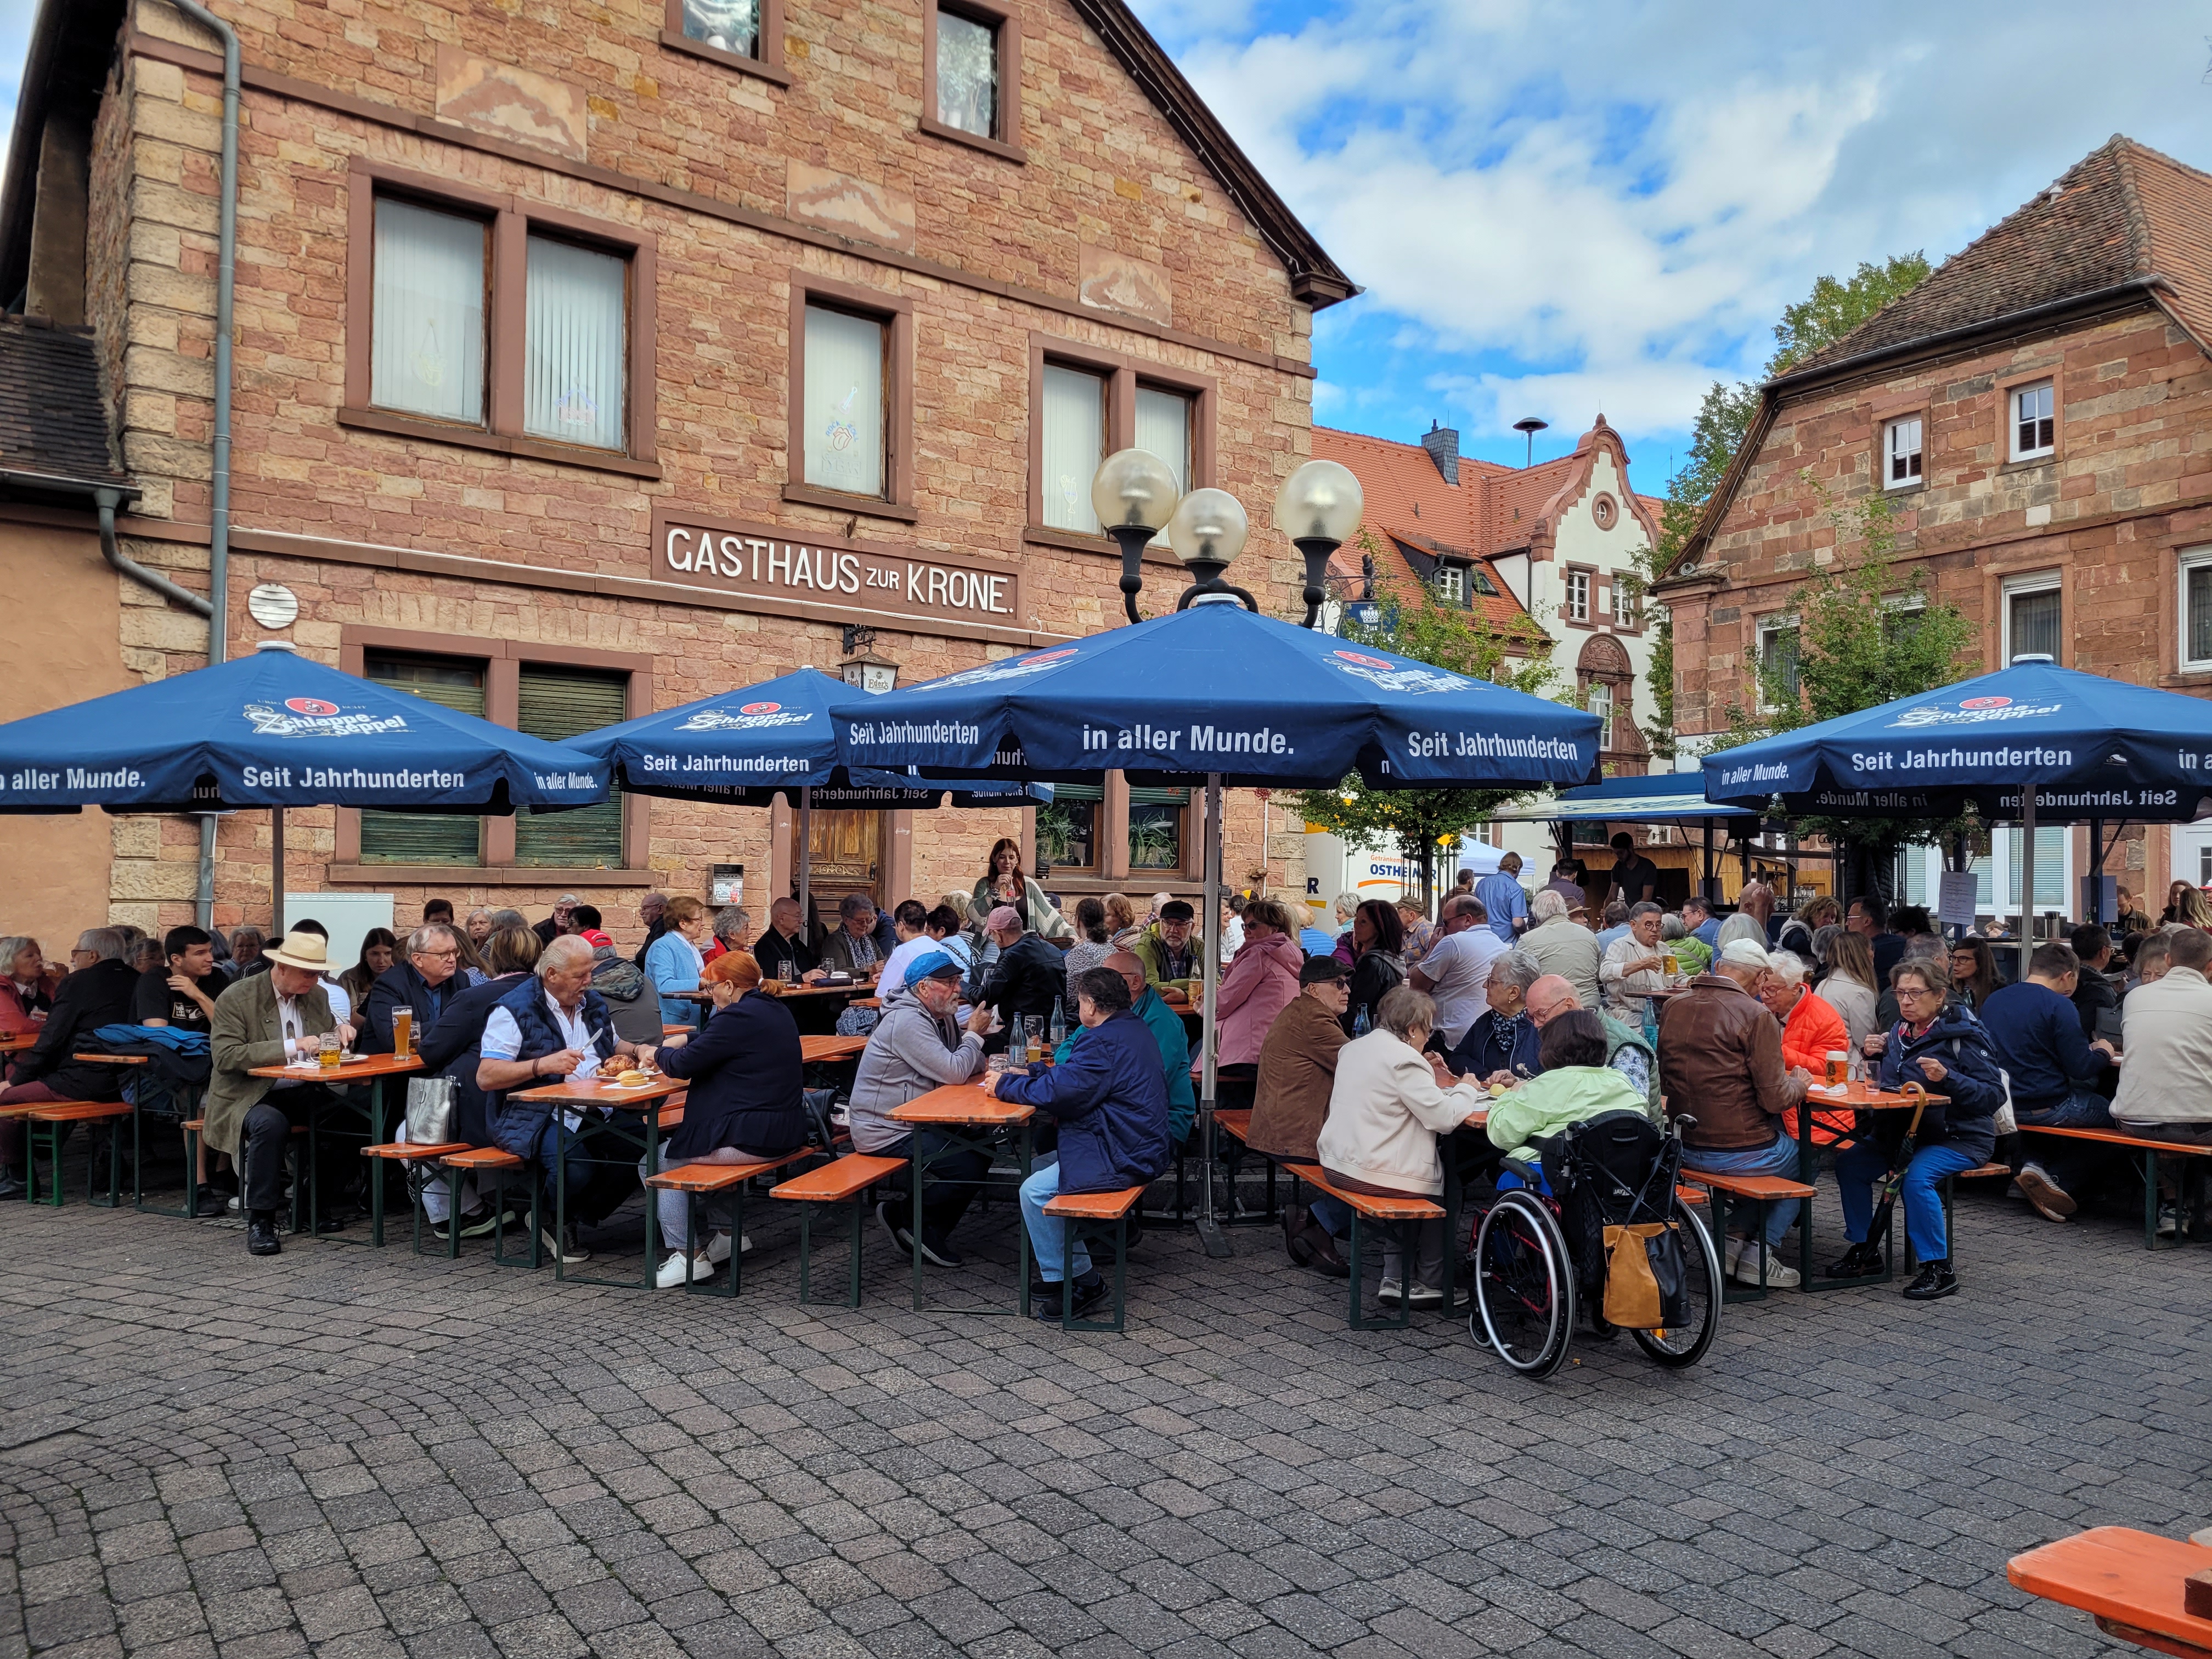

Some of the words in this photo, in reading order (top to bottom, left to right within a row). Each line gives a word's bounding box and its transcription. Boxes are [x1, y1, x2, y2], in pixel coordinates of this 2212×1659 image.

[667, 528, 860, 594] GASTHAUS
[866, 567, 900, 590] ZUR
[906, 563, 1014, 614] KRONE.
[868, 679, 889, 690] Eder's
[849, 722, 876, 745] Seit
[878, 720, 979, 744] Jahrhunderten
[1084, 724, 1107, 750] in
[1118, 724, 1181, 751] aller
[1190, 725, 1294, 754] Munde.
[1408, 731, 1449, 757] Seit
[1455, 732, 1578, 761] Jahrhunderten
[644, 754, 678, 771] Seit
[682, 754, 809, 772] Jahrhunderten
[1852, 752, 1893, 771] Seit
[1901, 747, 2072, 769] Jahrhunderten
[2179, 748, 2197, 769] in
[12, 769, 60, 790] aller
[66, 767, 145, 789] Munde.
[243, 766, 291, 787] Seit
[299, 768, 464, 788] Jahrhunderten
[534, 772, 546, 789] in
[546, 772, 567, 790] aller
[568, 772, 598, 789] Munde.
[1722, 769, 1730, 786] in
[1730, 766, 1752, 784] aller
[1753, 761, 1789, 781] Munde.
[1370, 864, 1437, 880] OSTHEMR
